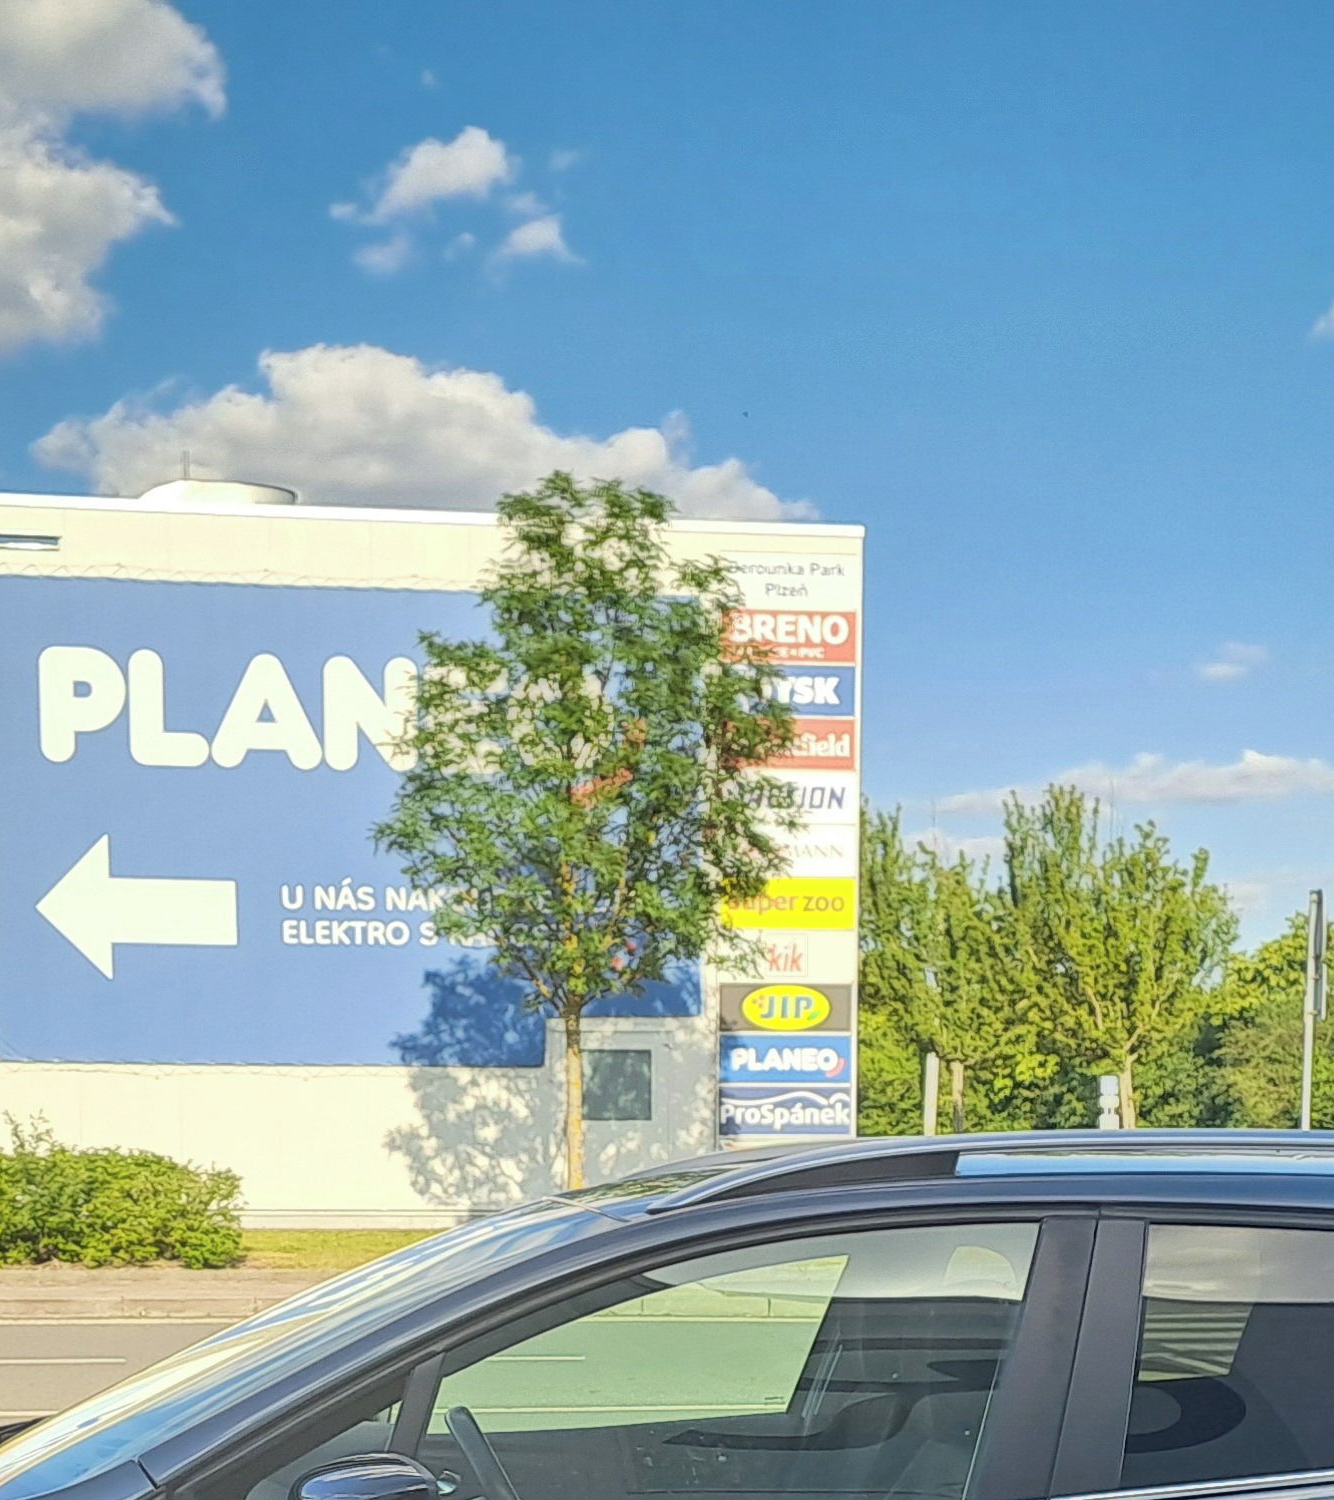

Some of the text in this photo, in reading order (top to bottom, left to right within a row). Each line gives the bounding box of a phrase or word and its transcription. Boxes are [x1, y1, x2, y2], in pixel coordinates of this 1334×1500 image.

[809, 562, 845, 577] Park
[731, 613, 849, 645] BRENO
[747, 784, 846, 810] AION
[280, 884, 303, 911] U
[314, 877, 376, 912] NÁS
[728, 894, 846, 915] super zoo
[282, 919, 410, 946] ELEKTRO
[418, 921, 439, 947] S
[759, 995, 815, 1020] JIP
[730, 1047, 839, 1072] PLANEO
[720, 1102, 850, 1132] ProSpánek
